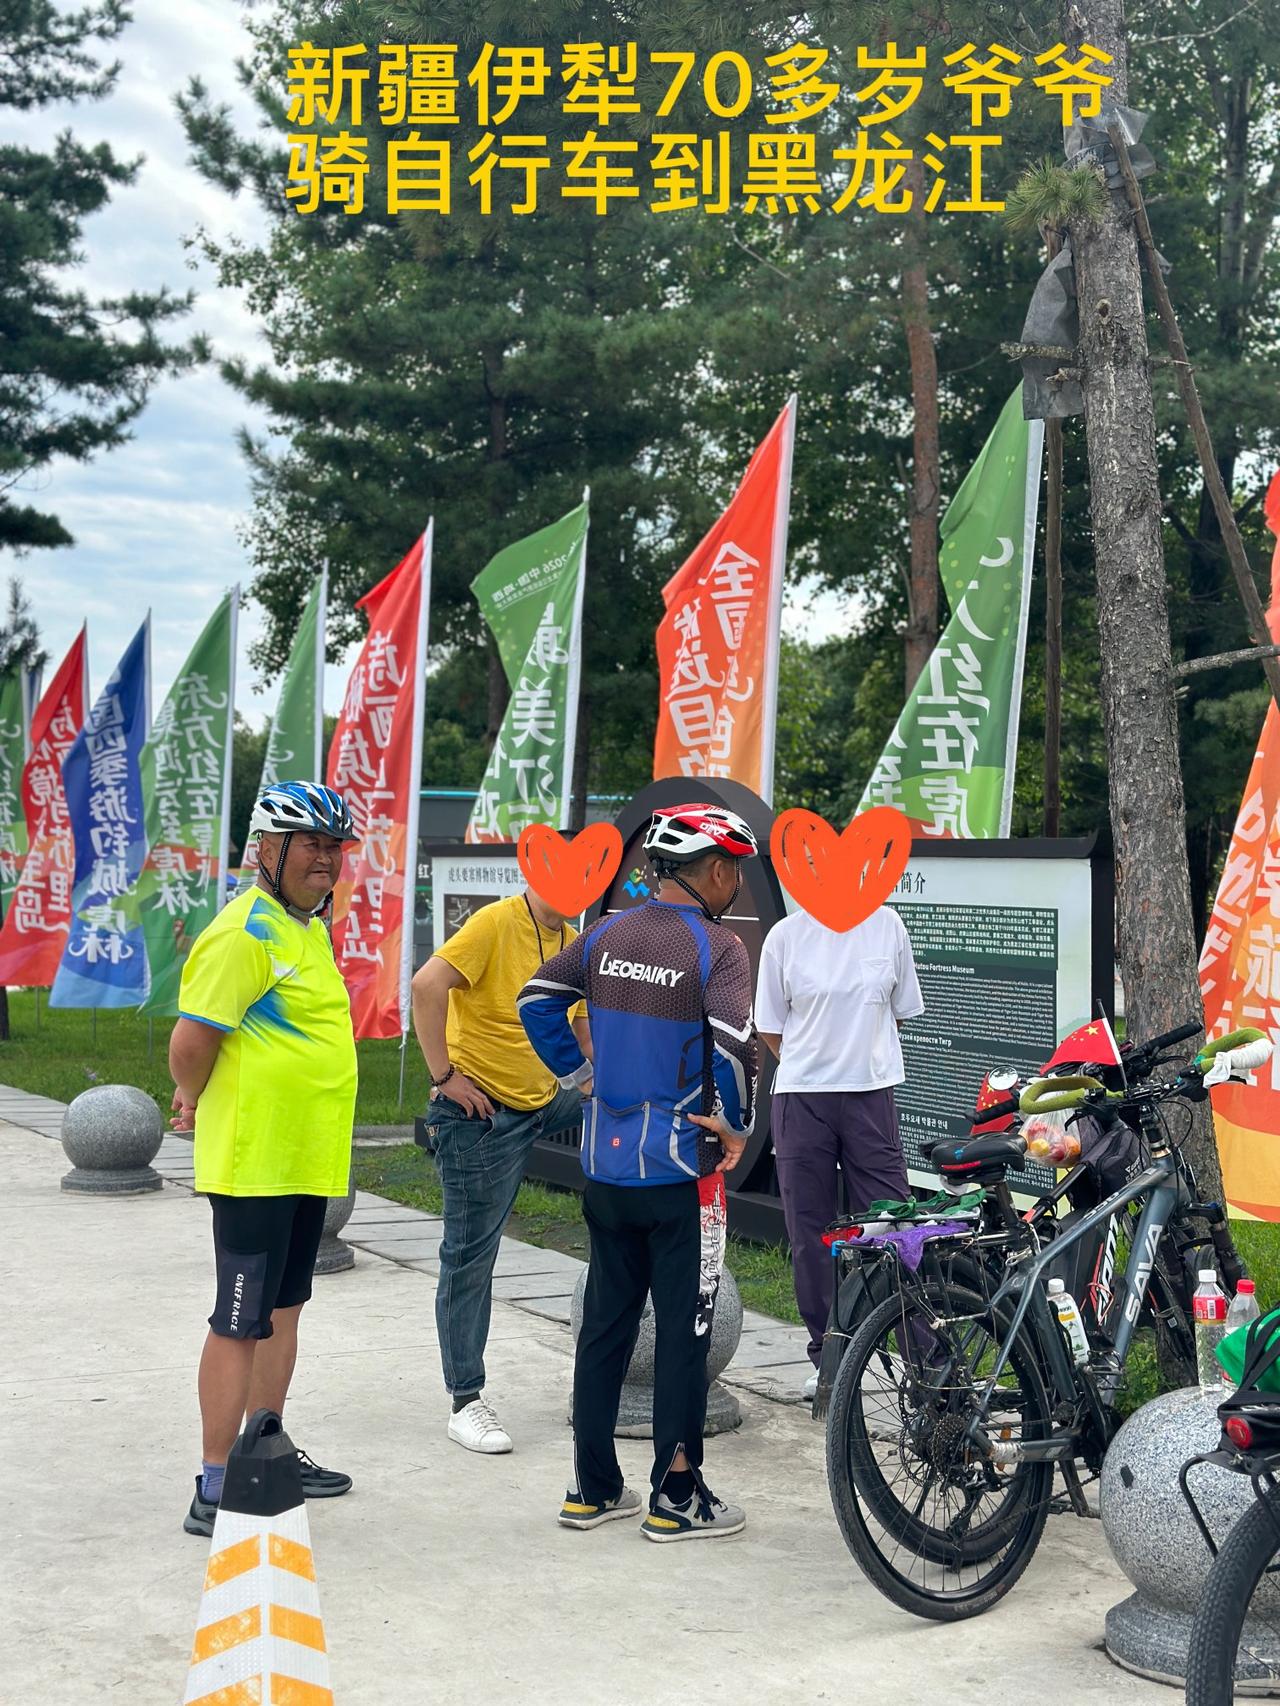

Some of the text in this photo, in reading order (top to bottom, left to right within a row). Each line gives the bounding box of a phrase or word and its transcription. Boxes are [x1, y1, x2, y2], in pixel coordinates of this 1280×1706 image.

[599, 952, 684, 987] LEOBAIKY
[952, 965, 975, 974] Museum
[1125, 1224, 1163, 1328] SAVA
